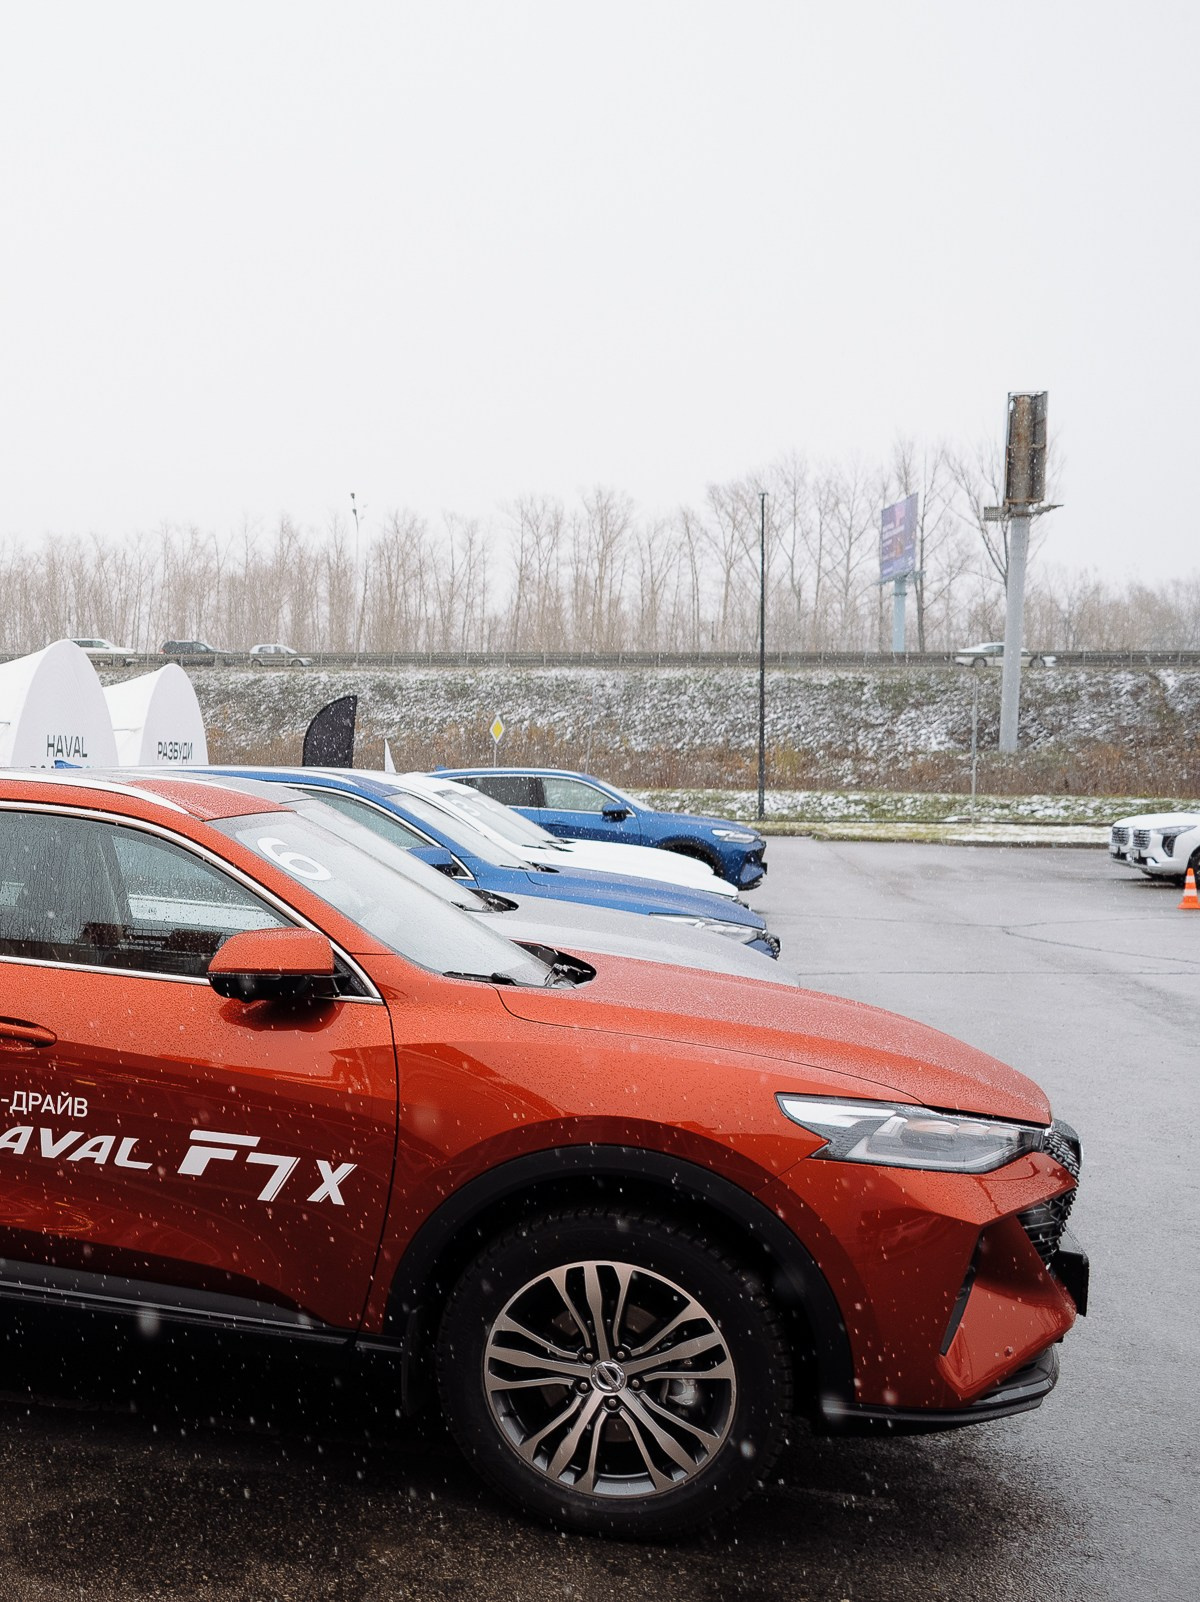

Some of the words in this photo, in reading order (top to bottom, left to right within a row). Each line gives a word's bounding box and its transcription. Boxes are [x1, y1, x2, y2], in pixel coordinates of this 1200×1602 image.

[46, 734, 88, 758] HAVAL
[157, 741, 193, 764] РАЗБУДИ
[256, 837, 332, 882] 6
